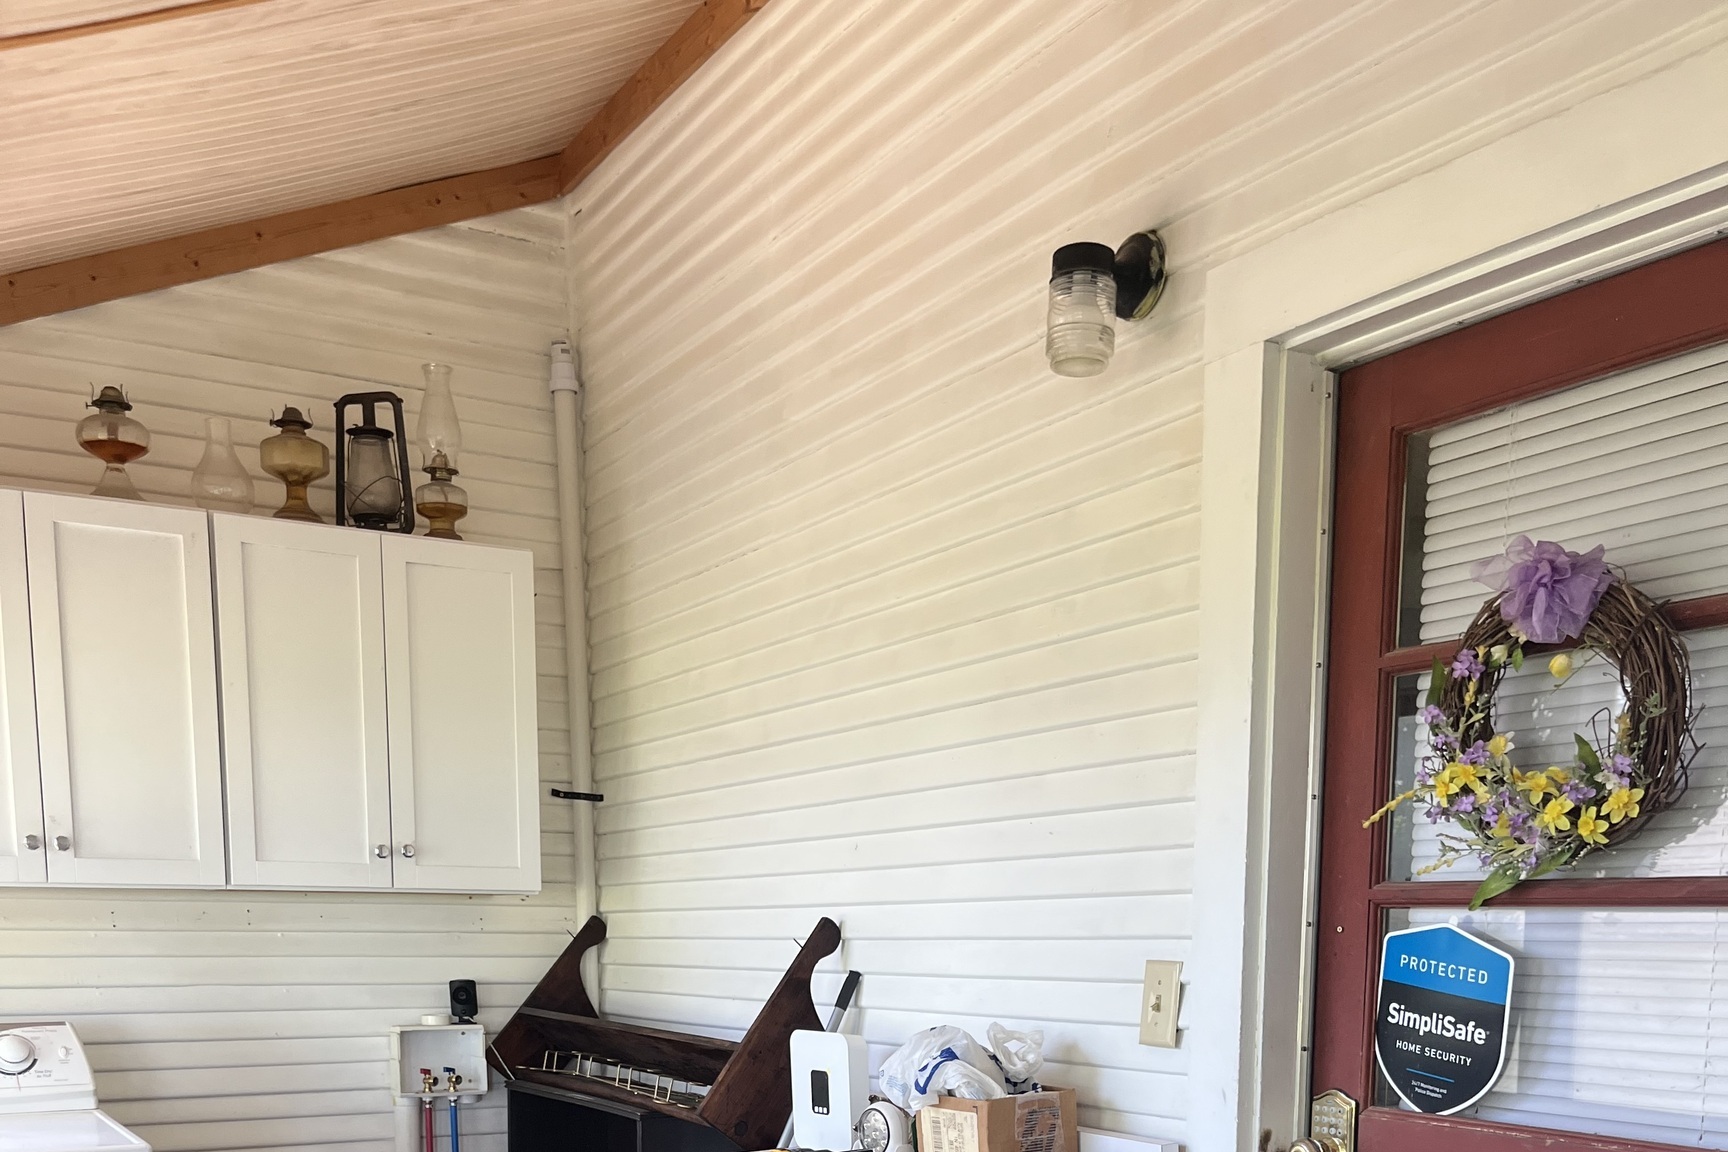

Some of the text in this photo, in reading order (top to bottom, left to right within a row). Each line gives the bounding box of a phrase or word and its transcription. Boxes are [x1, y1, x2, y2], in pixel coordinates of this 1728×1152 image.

[1399, 954, 1489, 985] PROTECTED
[1395, 1039, 1472, 1066] HOME SECURITY
